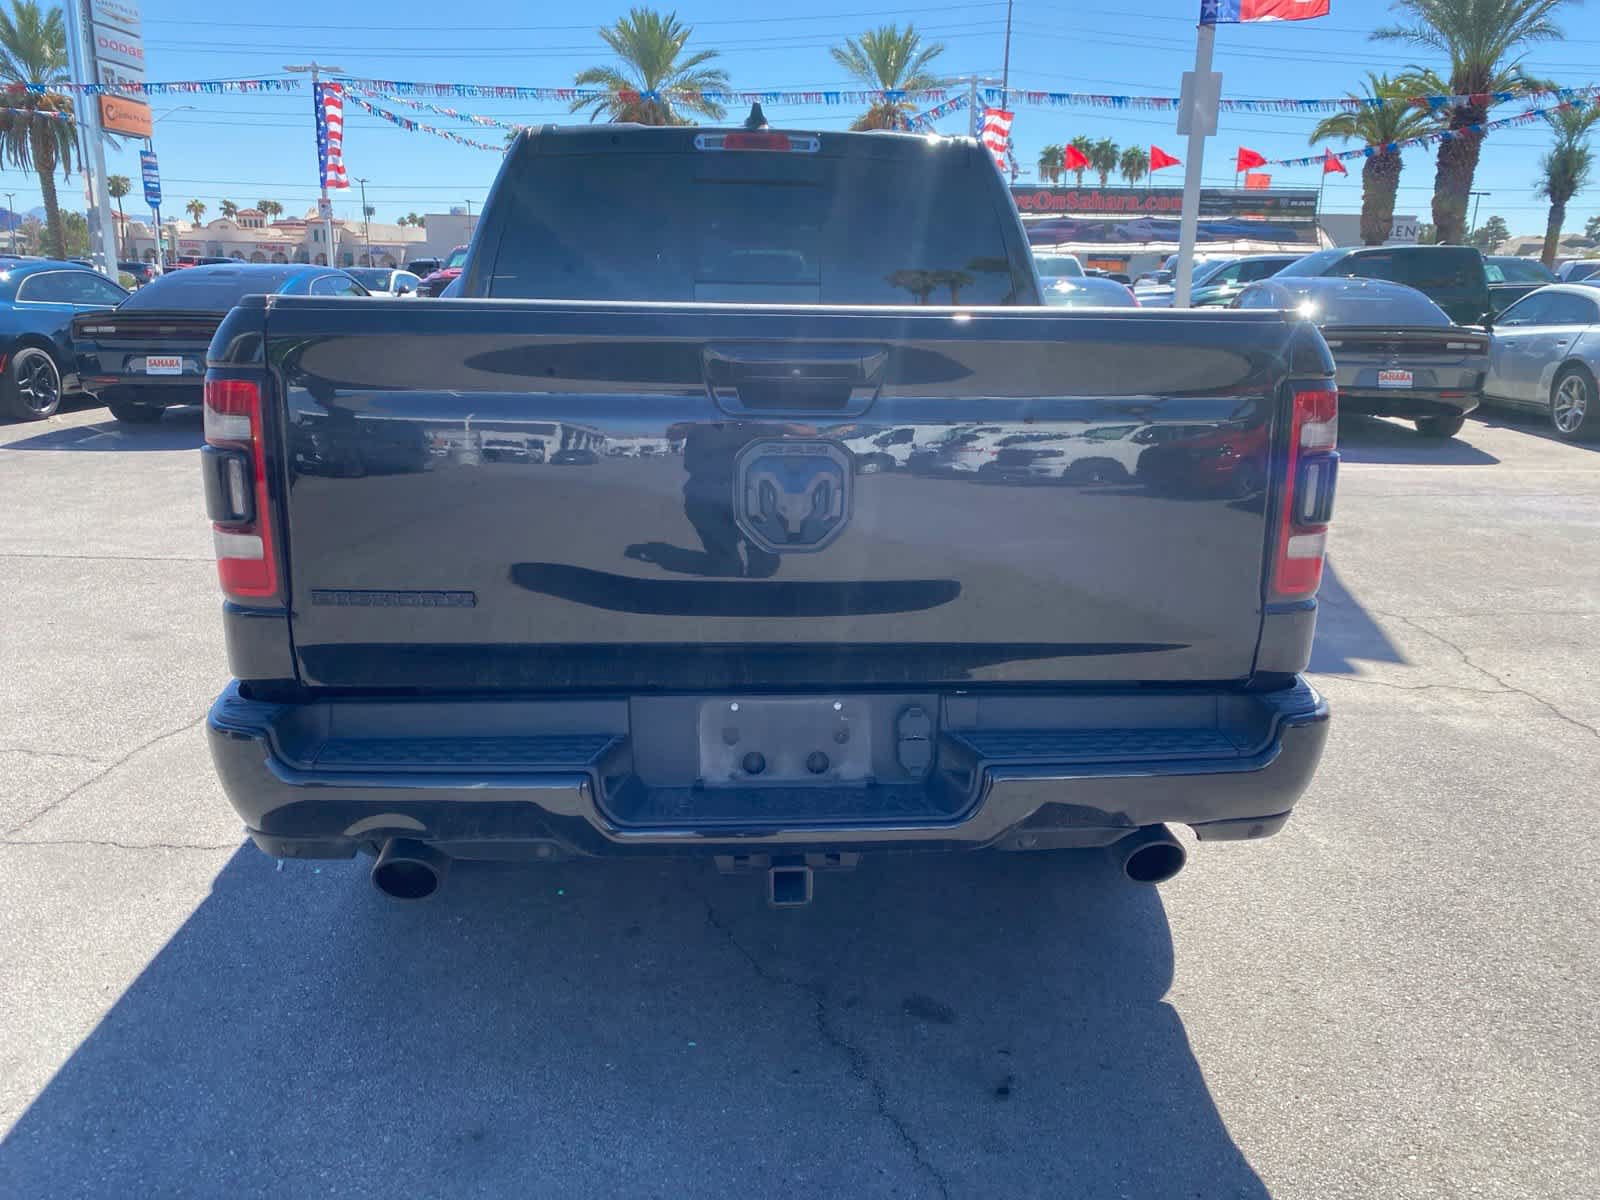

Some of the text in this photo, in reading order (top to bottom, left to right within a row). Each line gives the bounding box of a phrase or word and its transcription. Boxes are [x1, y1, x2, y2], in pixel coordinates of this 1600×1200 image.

[98, 37, 143, 58] DODGE
[148, 359, 180, 368] SAHARA
[1380, 372, 1411, 381] SAHARA
